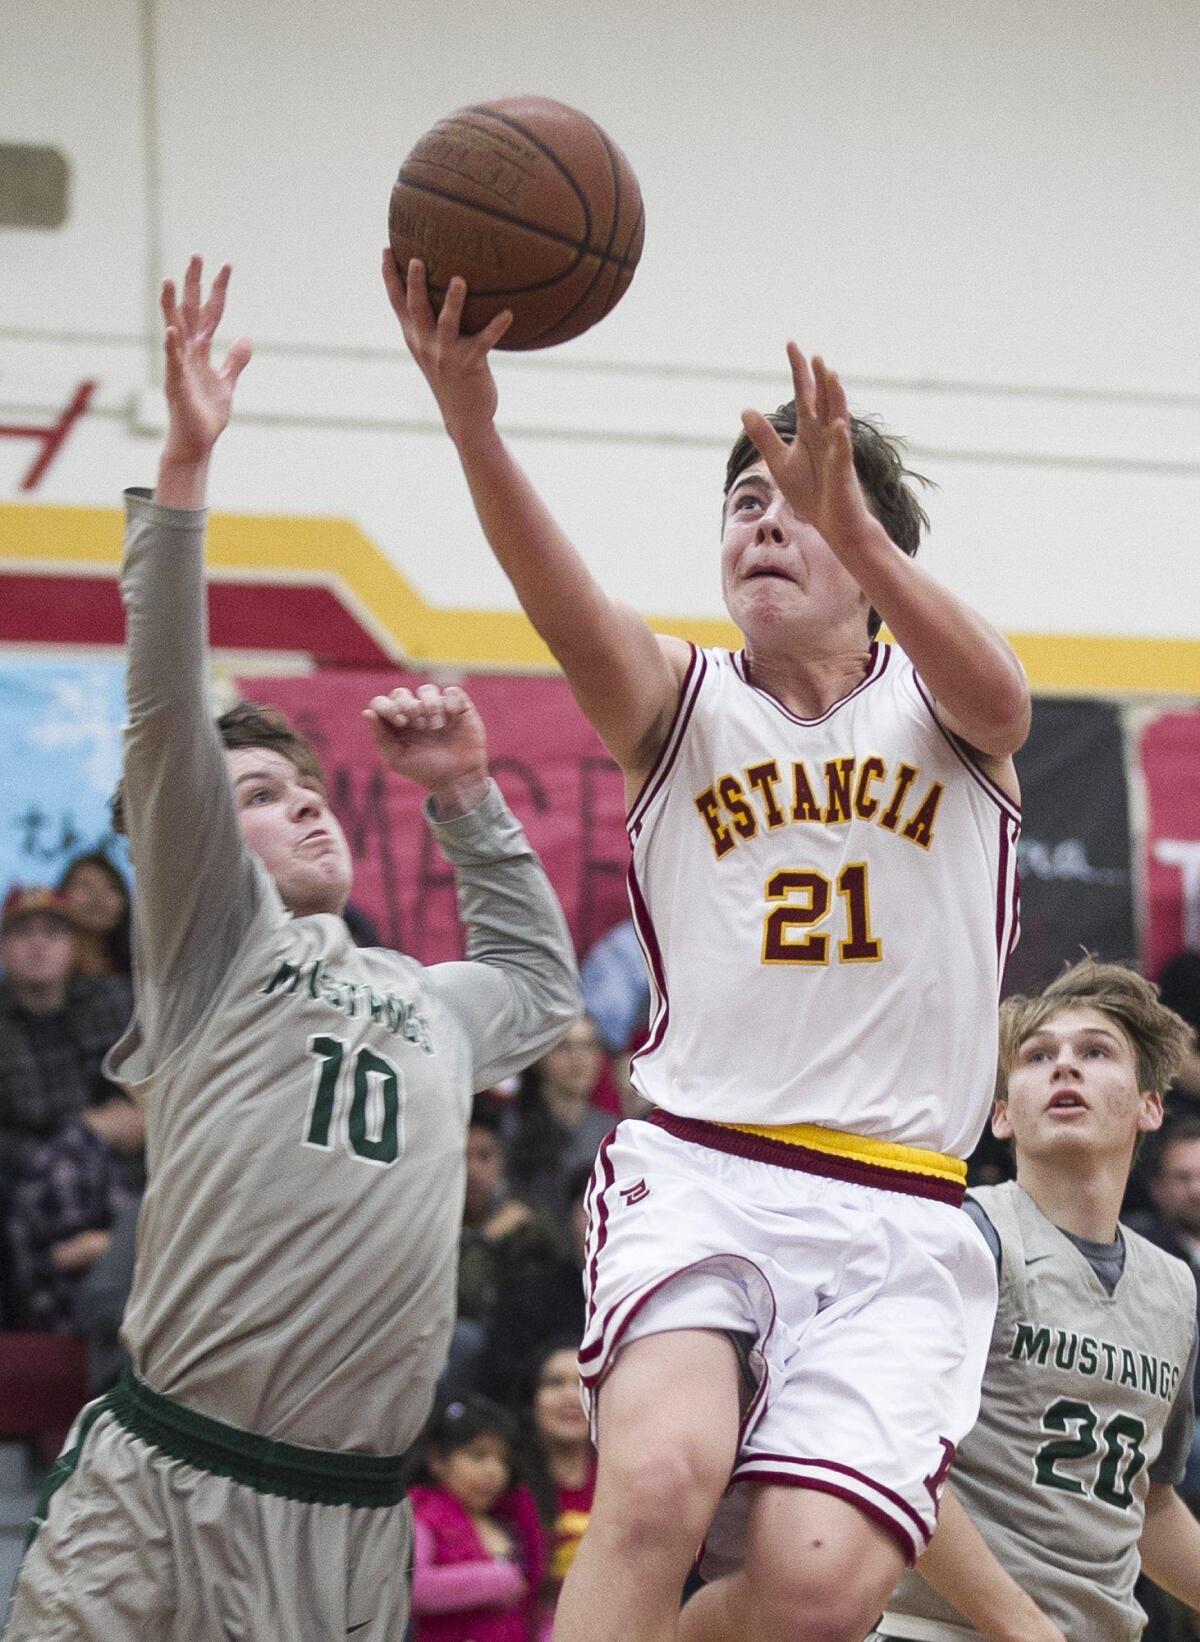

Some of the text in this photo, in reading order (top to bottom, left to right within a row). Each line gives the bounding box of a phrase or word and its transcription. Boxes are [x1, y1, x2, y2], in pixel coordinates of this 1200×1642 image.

[693, 756, 945, 861] ESTANCIA
[761, 861, 883, 966] 21
[303, 1032, 406, 1169] 10
[1007, 1322, 1180, 1403] MUSTANGS
[1032, 1395, 1147, 1511] 20
